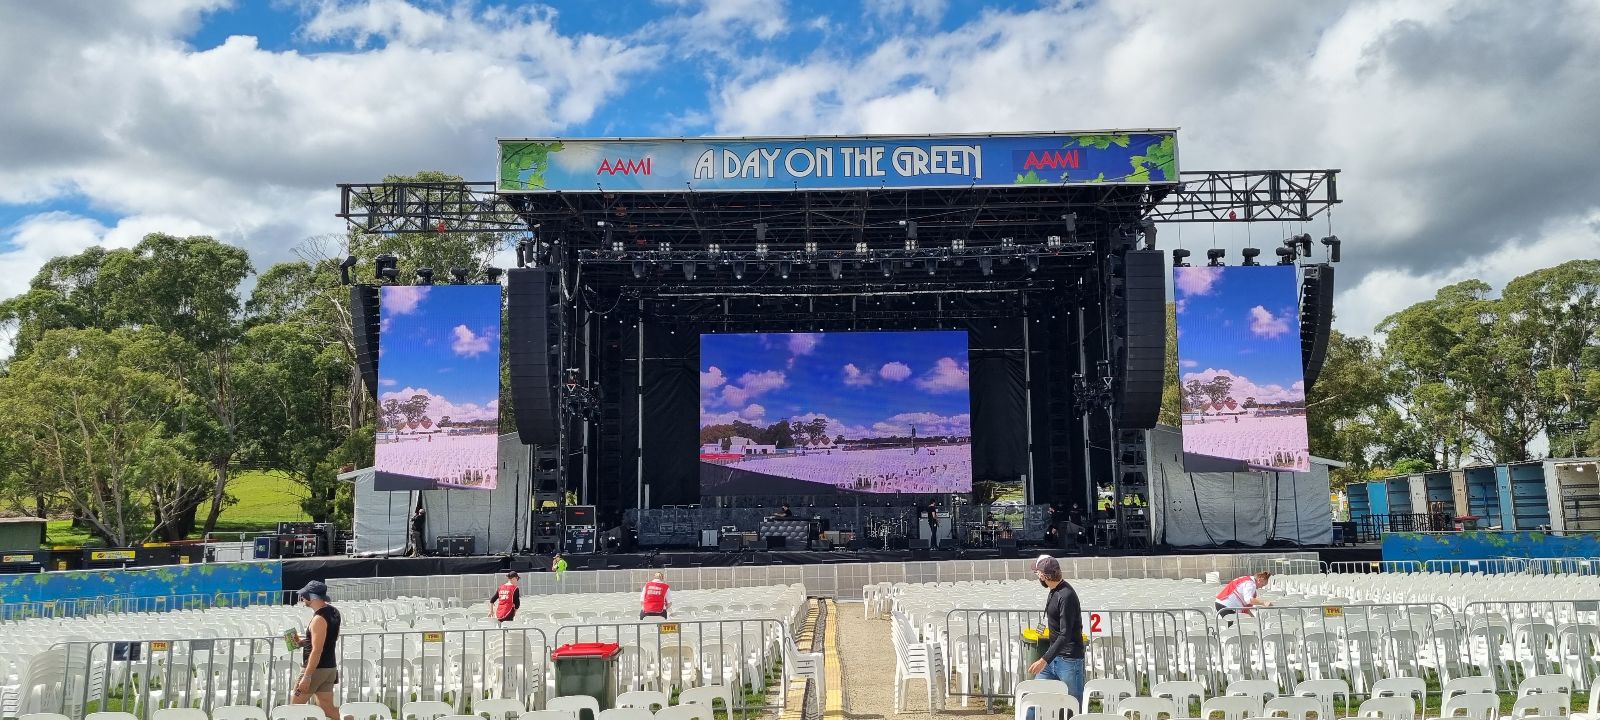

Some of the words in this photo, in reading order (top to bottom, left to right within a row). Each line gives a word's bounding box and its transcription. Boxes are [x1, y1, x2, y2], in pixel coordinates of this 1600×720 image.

[596, 157, 651, 176] AAMI
[694, 148, 715, 180] A
[723, 147, 782, 178] DAY
[784, 147, 833, 178] ON
[840, 146, 886, 177] THE
[891, 144, 982, 179] GREEN
[1023, 149, 1079, 170] AAMI
[1090, 613, 1102, 632] 2
